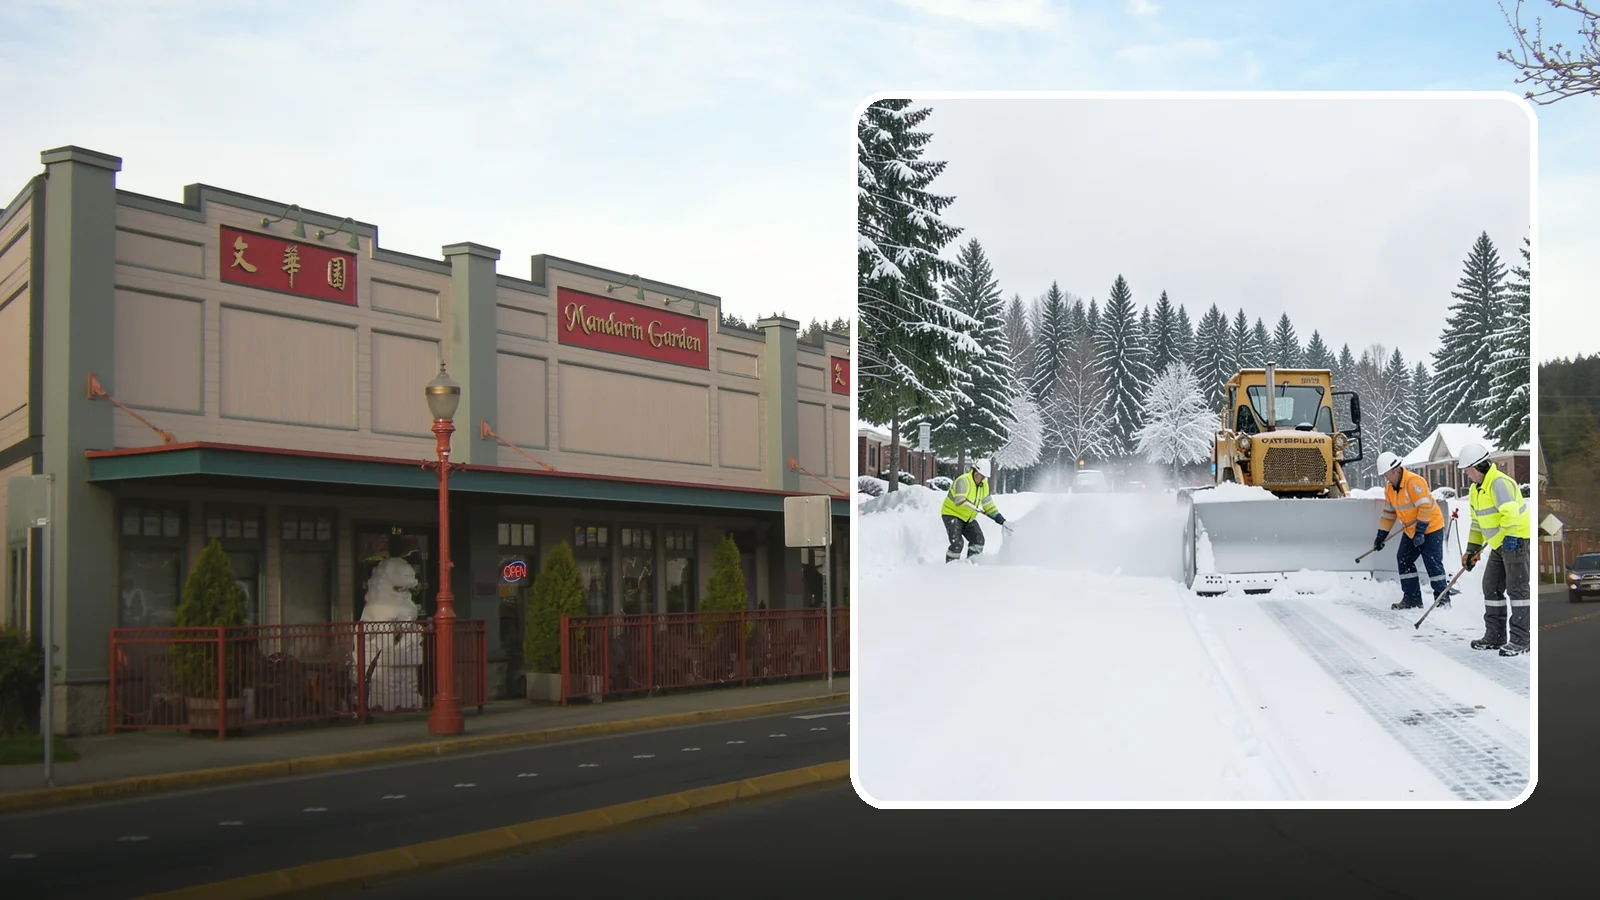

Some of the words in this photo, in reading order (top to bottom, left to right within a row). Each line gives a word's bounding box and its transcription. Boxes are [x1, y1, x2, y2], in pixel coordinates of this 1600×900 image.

[231, 236, 346, 291] 文華園
[565, 302, 644, 341] Mandarin
[648, 320, 701, 352] Garden
[503, 565, 527, 578] OPEN
